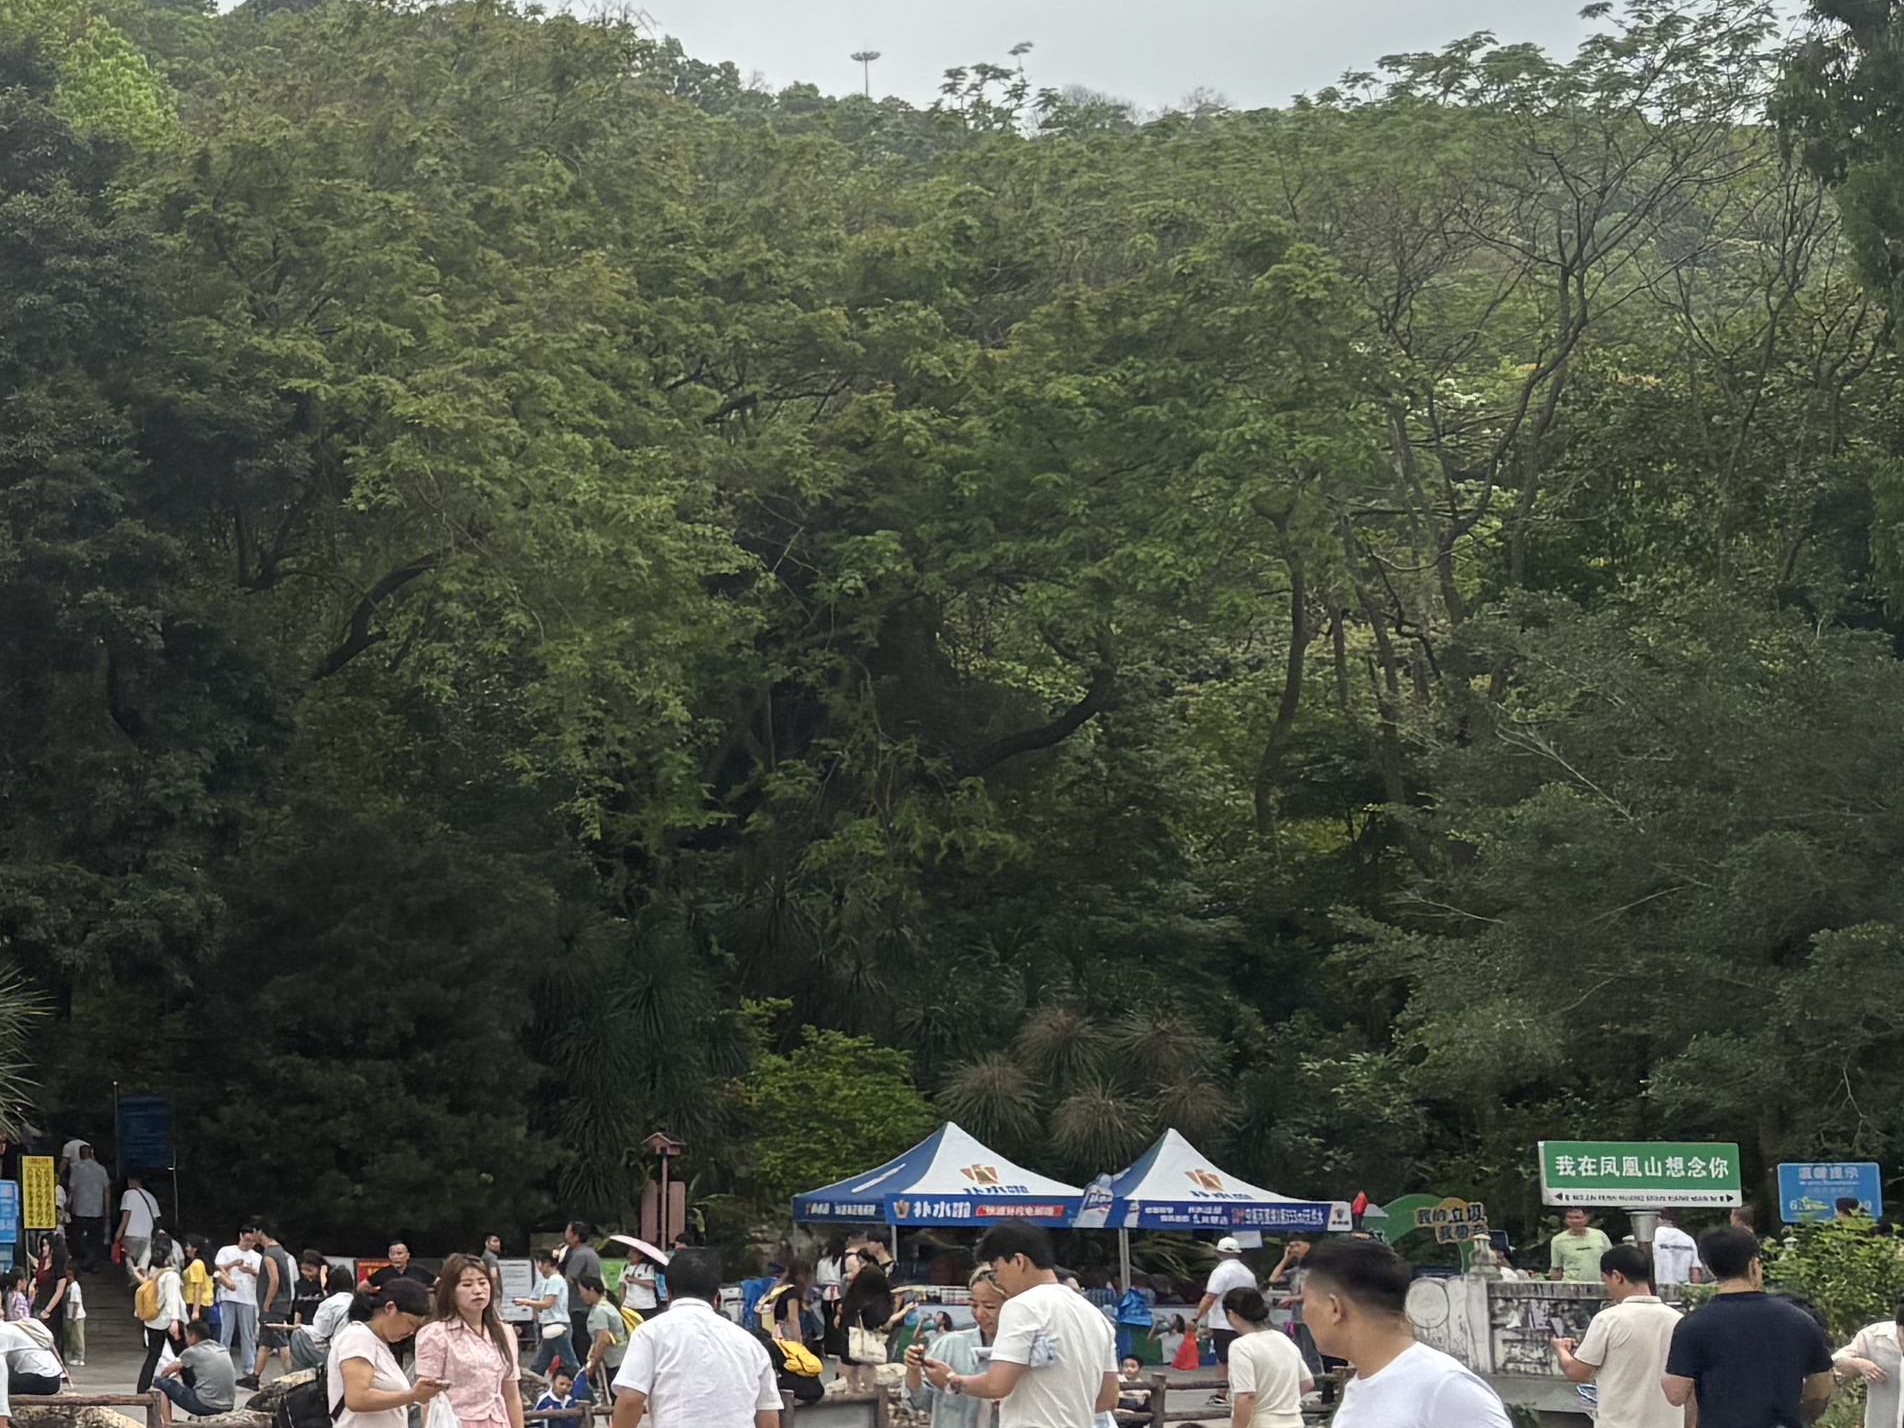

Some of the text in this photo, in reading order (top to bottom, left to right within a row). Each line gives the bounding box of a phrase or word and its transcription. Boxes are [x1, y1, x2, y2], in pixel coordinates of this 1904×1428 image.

[1555, 1154, 1729, 1179] 我在凤凰山想念你
